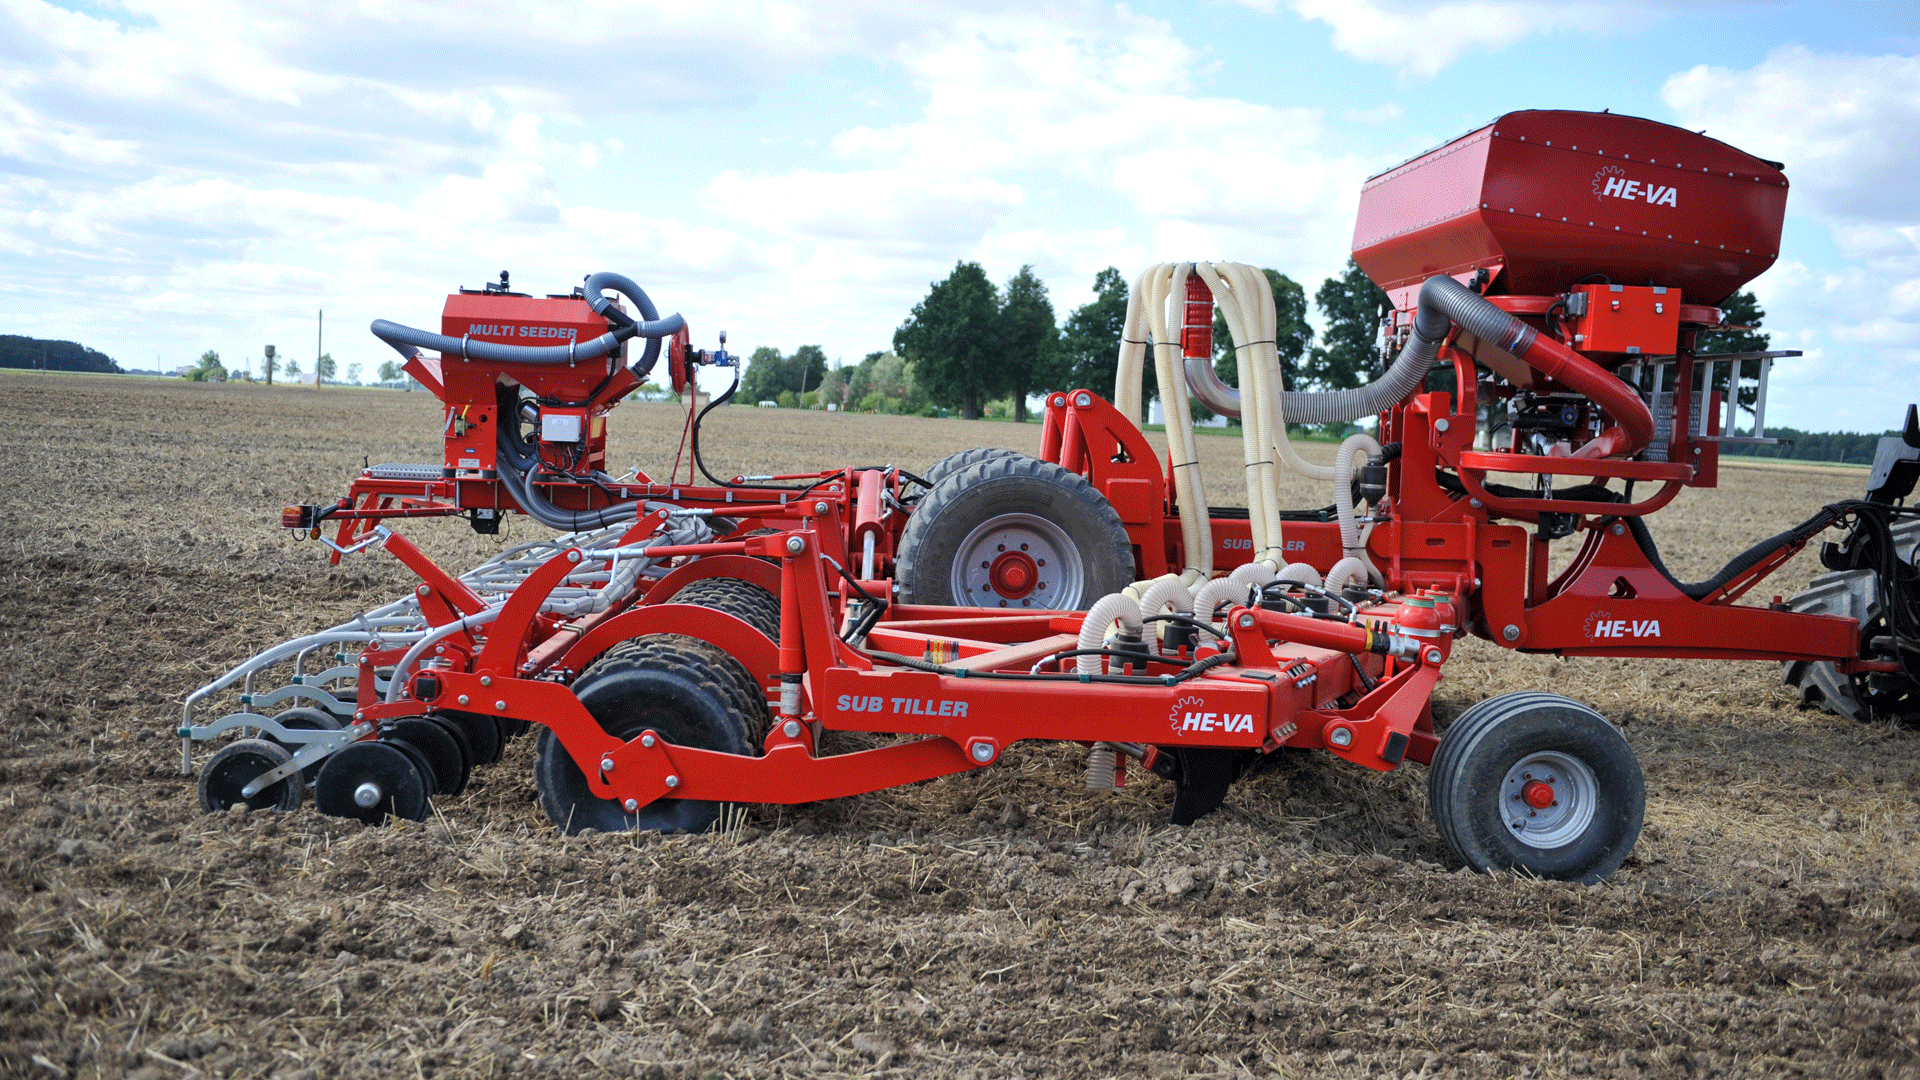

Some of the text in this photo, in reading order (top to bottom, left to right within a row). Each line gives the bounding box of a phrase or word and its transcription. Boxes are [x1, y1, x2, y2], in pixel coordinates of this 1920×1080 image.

[1603, 177, 1677, 208] HE-VA
[469, 324, 577, 339] MULTI SEEDER
[1223, 539, 1252, 550] SUB
[1594, 620, 1661, 637] HE-VA
[836, 695, 969, 717] SUB TILLER
[1182, 712, 1254, 733] HE-VA
